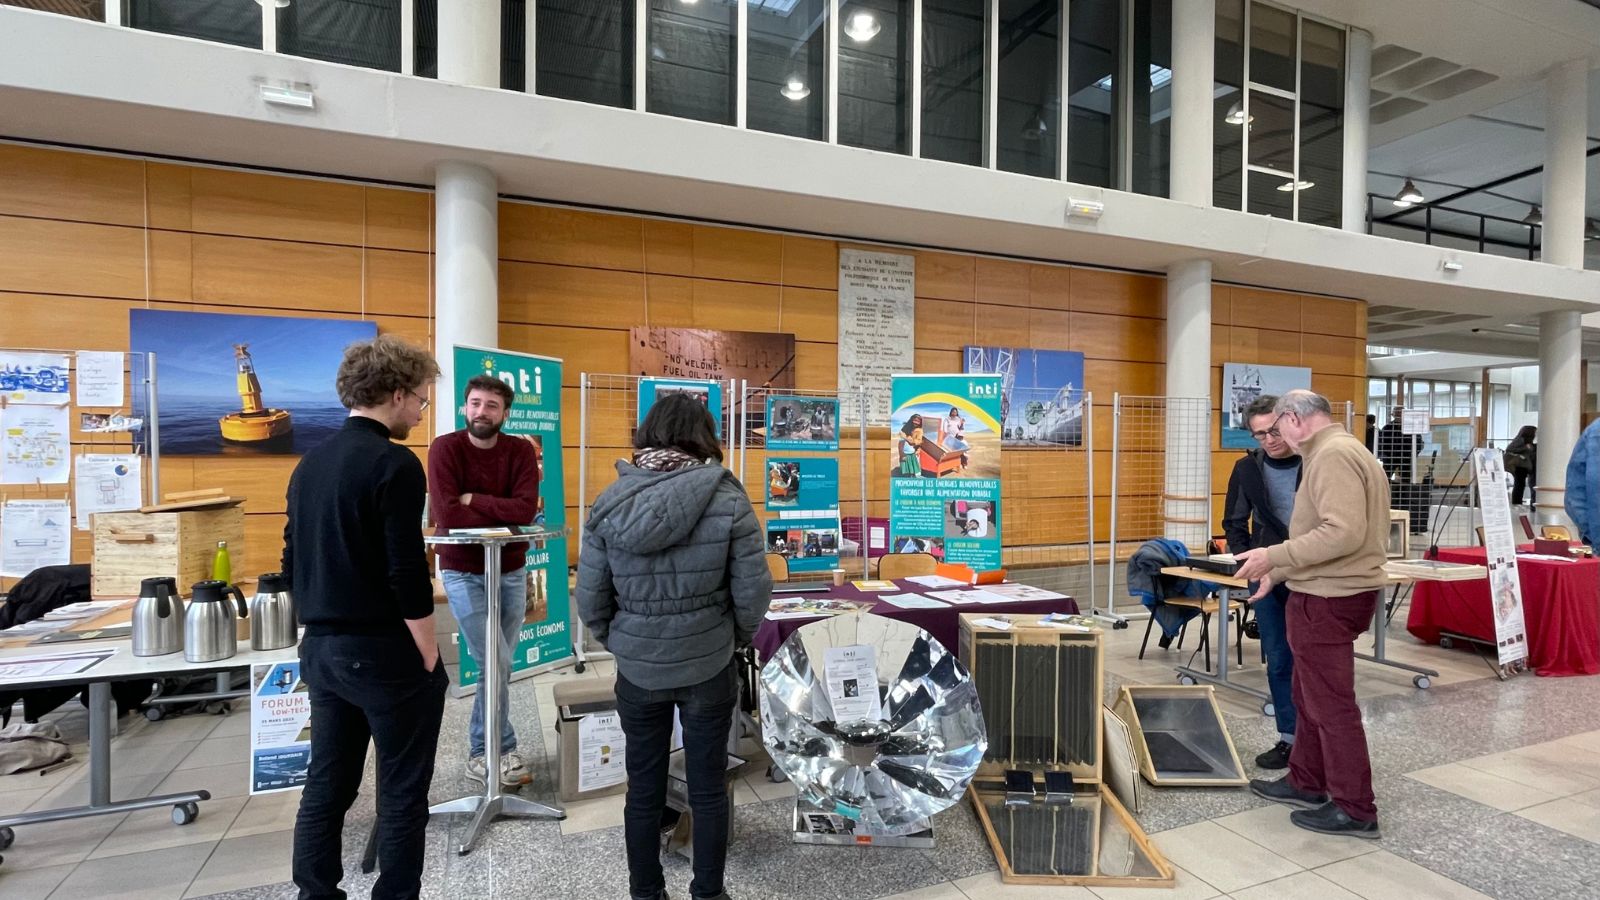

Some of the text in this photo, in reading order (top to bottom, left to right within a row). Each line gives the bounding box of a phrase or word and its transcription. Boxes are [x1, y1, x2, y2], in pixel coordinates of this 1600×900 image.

[664, 365, 685, 376] FUEL
[970, 382, 997, 394] inti
[505, 420, 537, 430] ALIMENTATION
[937, 489, 970, 497] ALIMENTATION
[972, 490, 991, 498] DURABLE
[526, 552, 549, 566] SOLAIRE
[520, 621, 564, 642] BOIS ÉCONOME
[262, 697, 303, 709] FORUM
[272, 707, 309, 716] LOW-TECH
